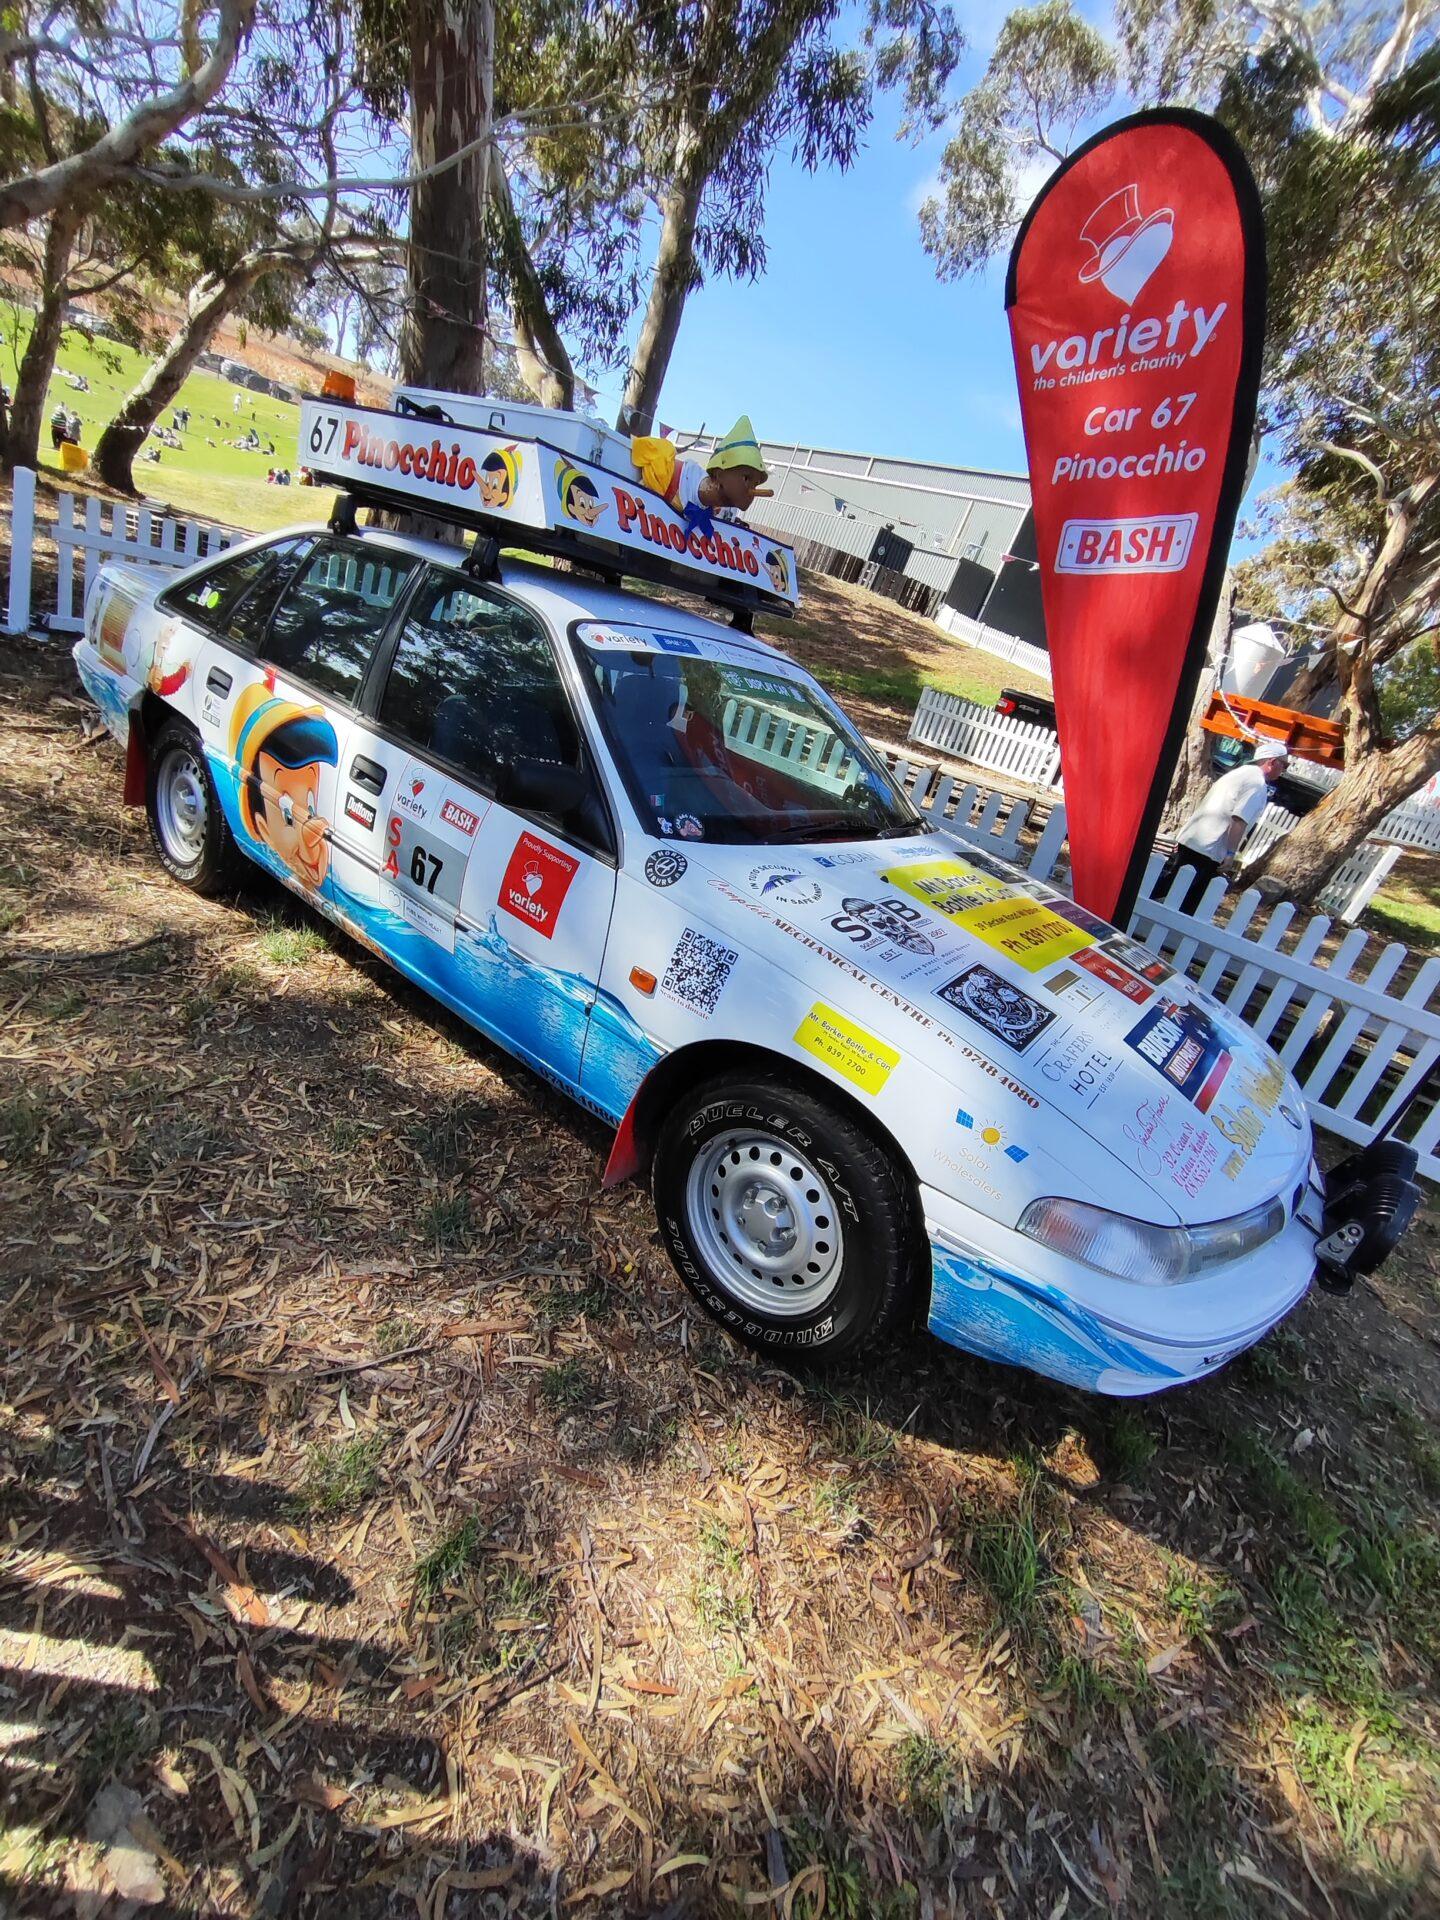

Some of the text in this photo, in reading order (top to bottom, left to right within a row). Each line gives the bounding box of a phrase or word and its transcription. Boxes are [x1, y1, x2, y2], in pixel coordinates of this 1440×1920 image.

[1030, 300, 1227, 375] variety
[1033, 351, 1187, 392] the children's charity
[1083, 392, 1198, 436] Car 67
[310, 416, 476, 490] 67 Pinocchio
[1051, 440, 1206, 486] Pinocchio
[611, 486, 760, 578] Pinocchio
[1075, 525, 1175, 564] BASH
[397, 793, 427, 819] variety
[445, 805, 473, 831] BASH
[411, 846, 443, 894] 67
[523, 837, 572, 872] Proudly Supporting
[647, 862, 673, 886] LEISURE
[657, 851, 686, 872] HORIZON
[758, 865, 802, 875] SECURITY
[913, 874, 984, 895] Mt Barker
[931, 889, 983, 915] Bottle
[990, 886, 1018, 902] Can
[509, 889, 548, 922] variety
[880, 900, 921, 922] B
[831, 916, 872, 942] S
[1000, 937, 1031, 954] Ph.
[660, 989, 710, 1020] Scan to donate
[707, 879, 1040, 1109] Complete MECHANICAL CENTRE Ph. 9748 4080
[808, 1012, 891, 1071] Mt. Barker Bottle & Can
[814, 1036, 867, 1075] Ph. 8391 2700
[1041, 1030, 1095, 1082] CRAFERS
[1137, 1015, 1184, 1066] BURSON
[1069, 1050, 1112, 1097] HOTEL
[688, 1103, 860, 1223] DUELER A/T
[933, 1148, 1003, 1201] Wholesalers
[959, 1147, 991, 1172] Solar
[1162, 1151, 1178, 1169] 32
